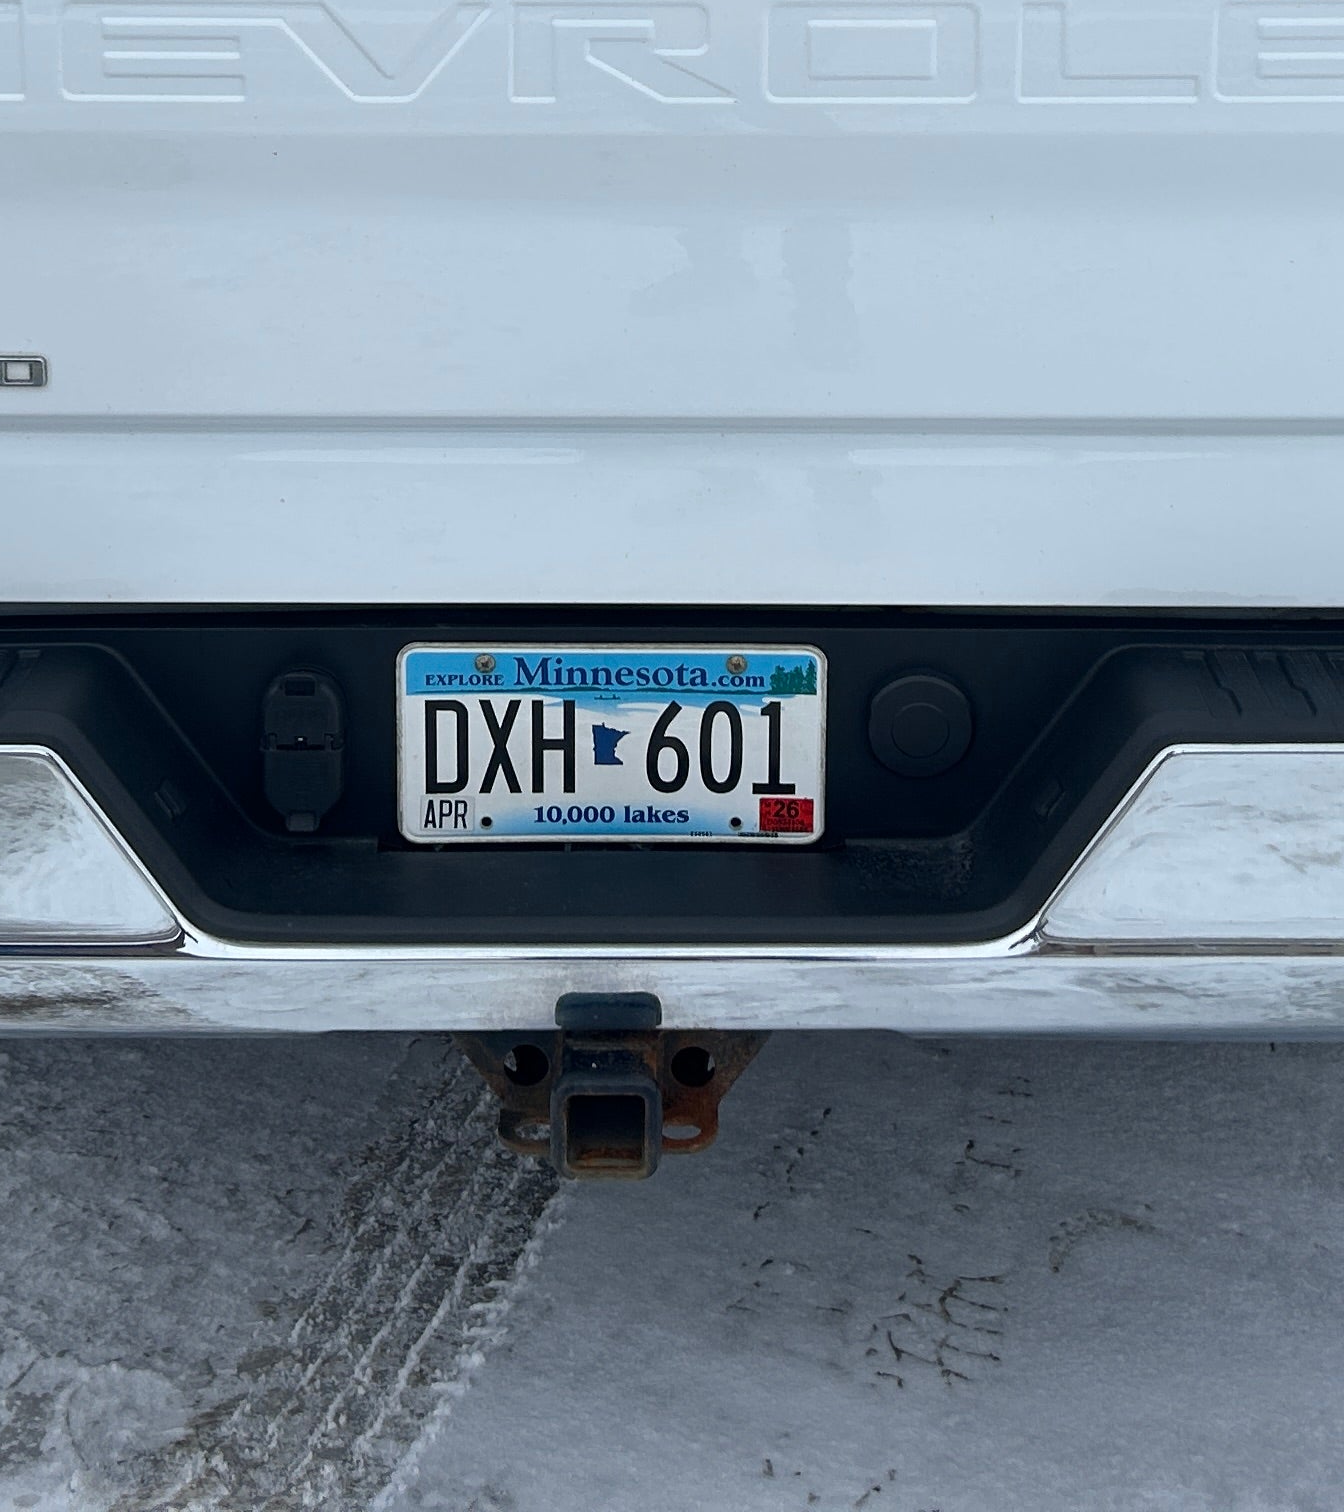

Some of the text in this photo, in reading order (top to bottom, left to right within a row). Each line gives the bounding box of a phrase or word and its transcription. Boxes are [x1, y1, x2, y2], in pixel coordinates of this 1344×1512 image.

[425, 656, 765, 688] EXPLORE Minnesota.com
[425, 699, 796, 795] DXH 601
[423, 799, 468, 829] APR
[533, 804, 690, 826] 10,000 lakes
[772, 799, 800, 819] 26
